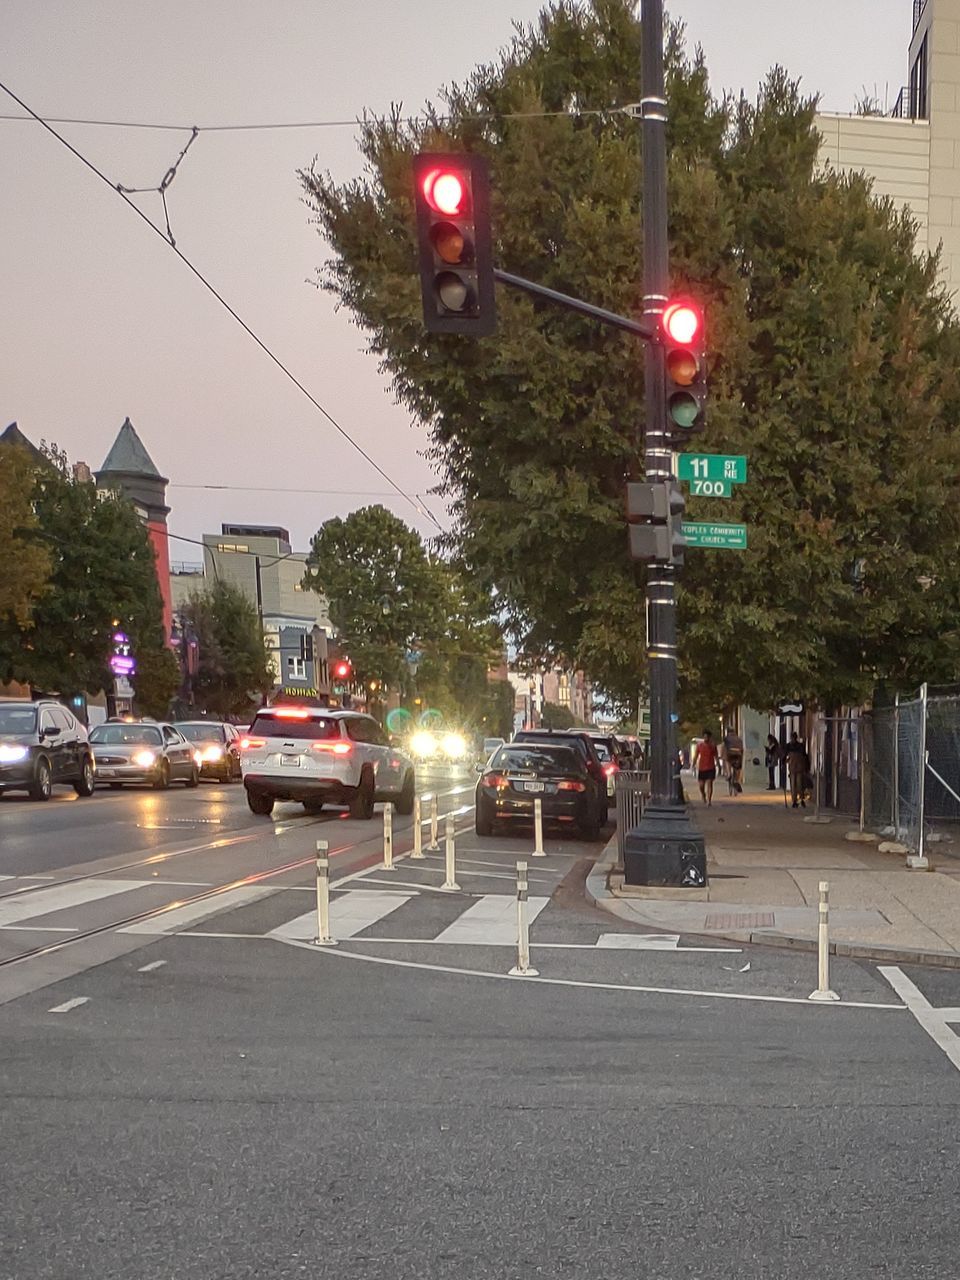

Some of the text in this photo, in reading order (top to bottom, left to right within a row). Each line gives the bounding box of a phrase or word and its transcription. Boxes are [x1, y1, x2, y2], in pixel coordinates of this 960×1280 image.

[690, 458, 736, 478] 11 ST
[724, 470, 737, 479] NE
[693, 480, 724, 495] 700
